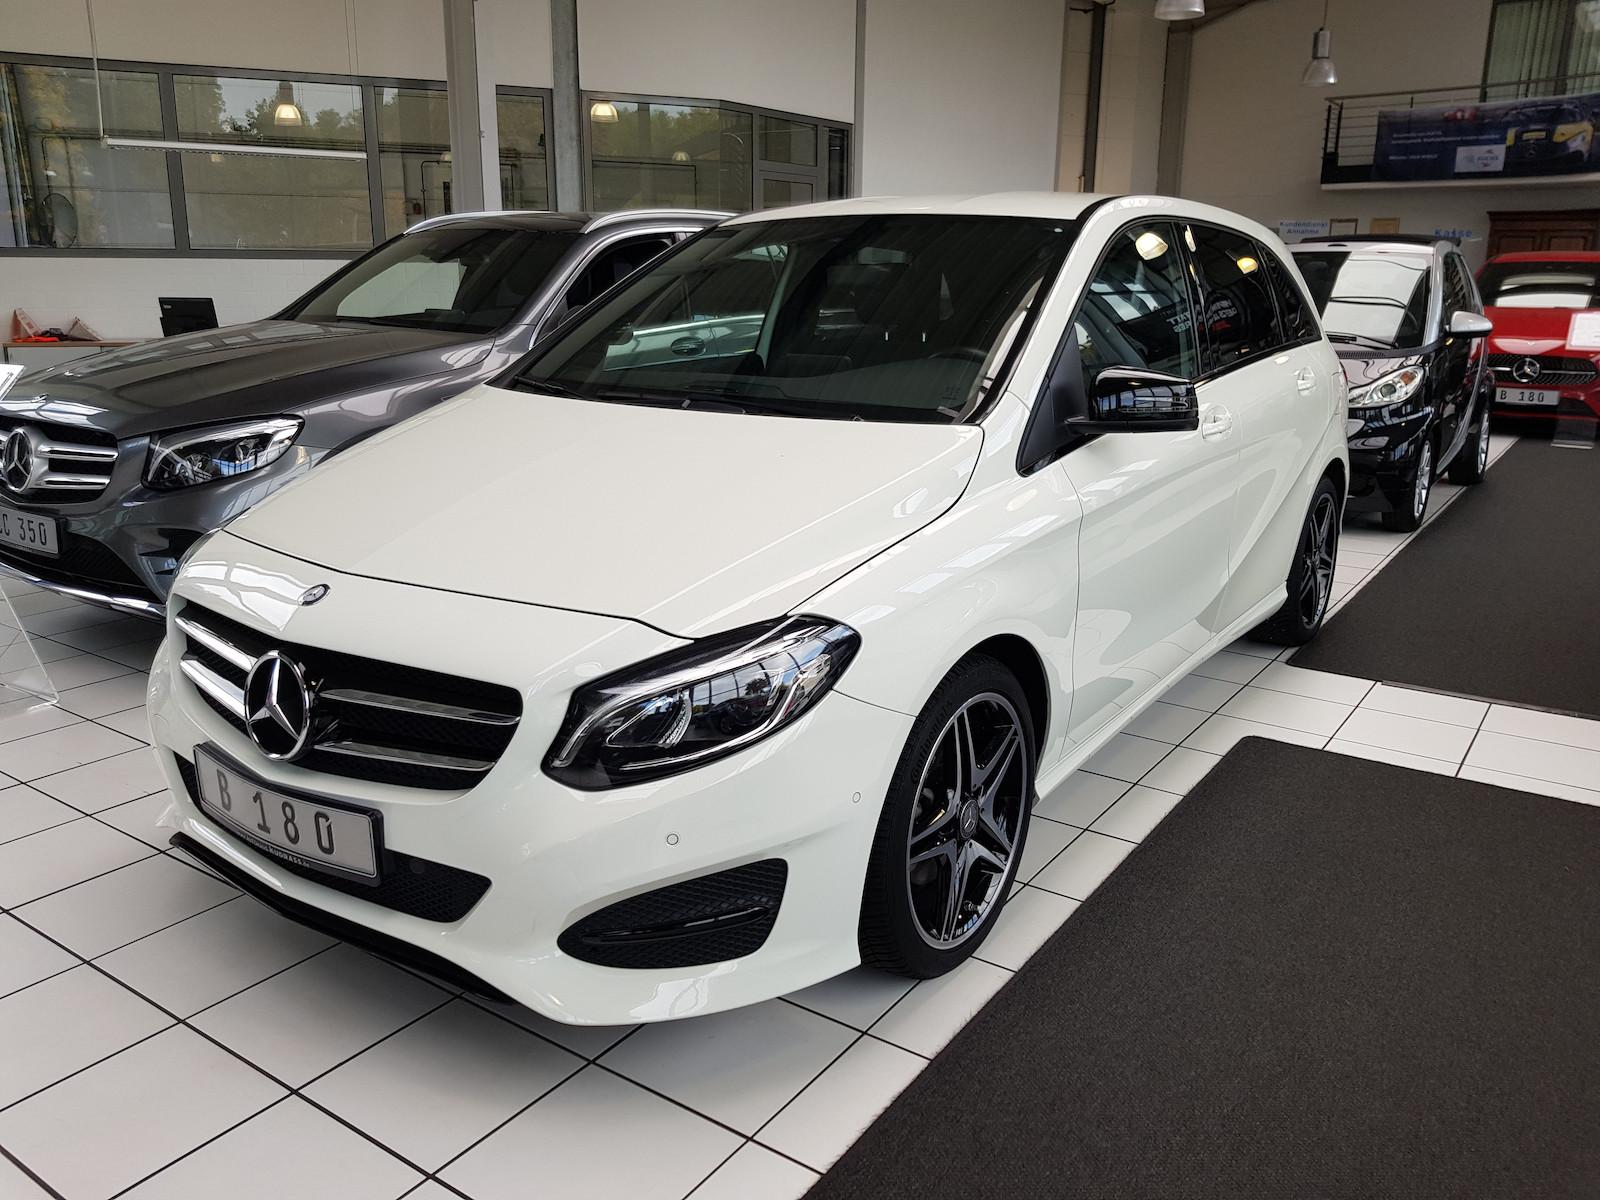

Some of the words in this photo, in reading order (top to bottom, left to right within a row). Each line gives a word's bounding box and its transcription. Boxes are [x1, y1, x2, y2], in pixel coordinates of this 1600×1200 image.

[1434, 228, 1473, 238] Kasse
[1500, 389, 1507, 400] B
[1518, 391, 1545, 402] 180
[17, 517, 47, 545] 350
[216, 768, 231, 812] B
[252, 790, 335, 855] 180
